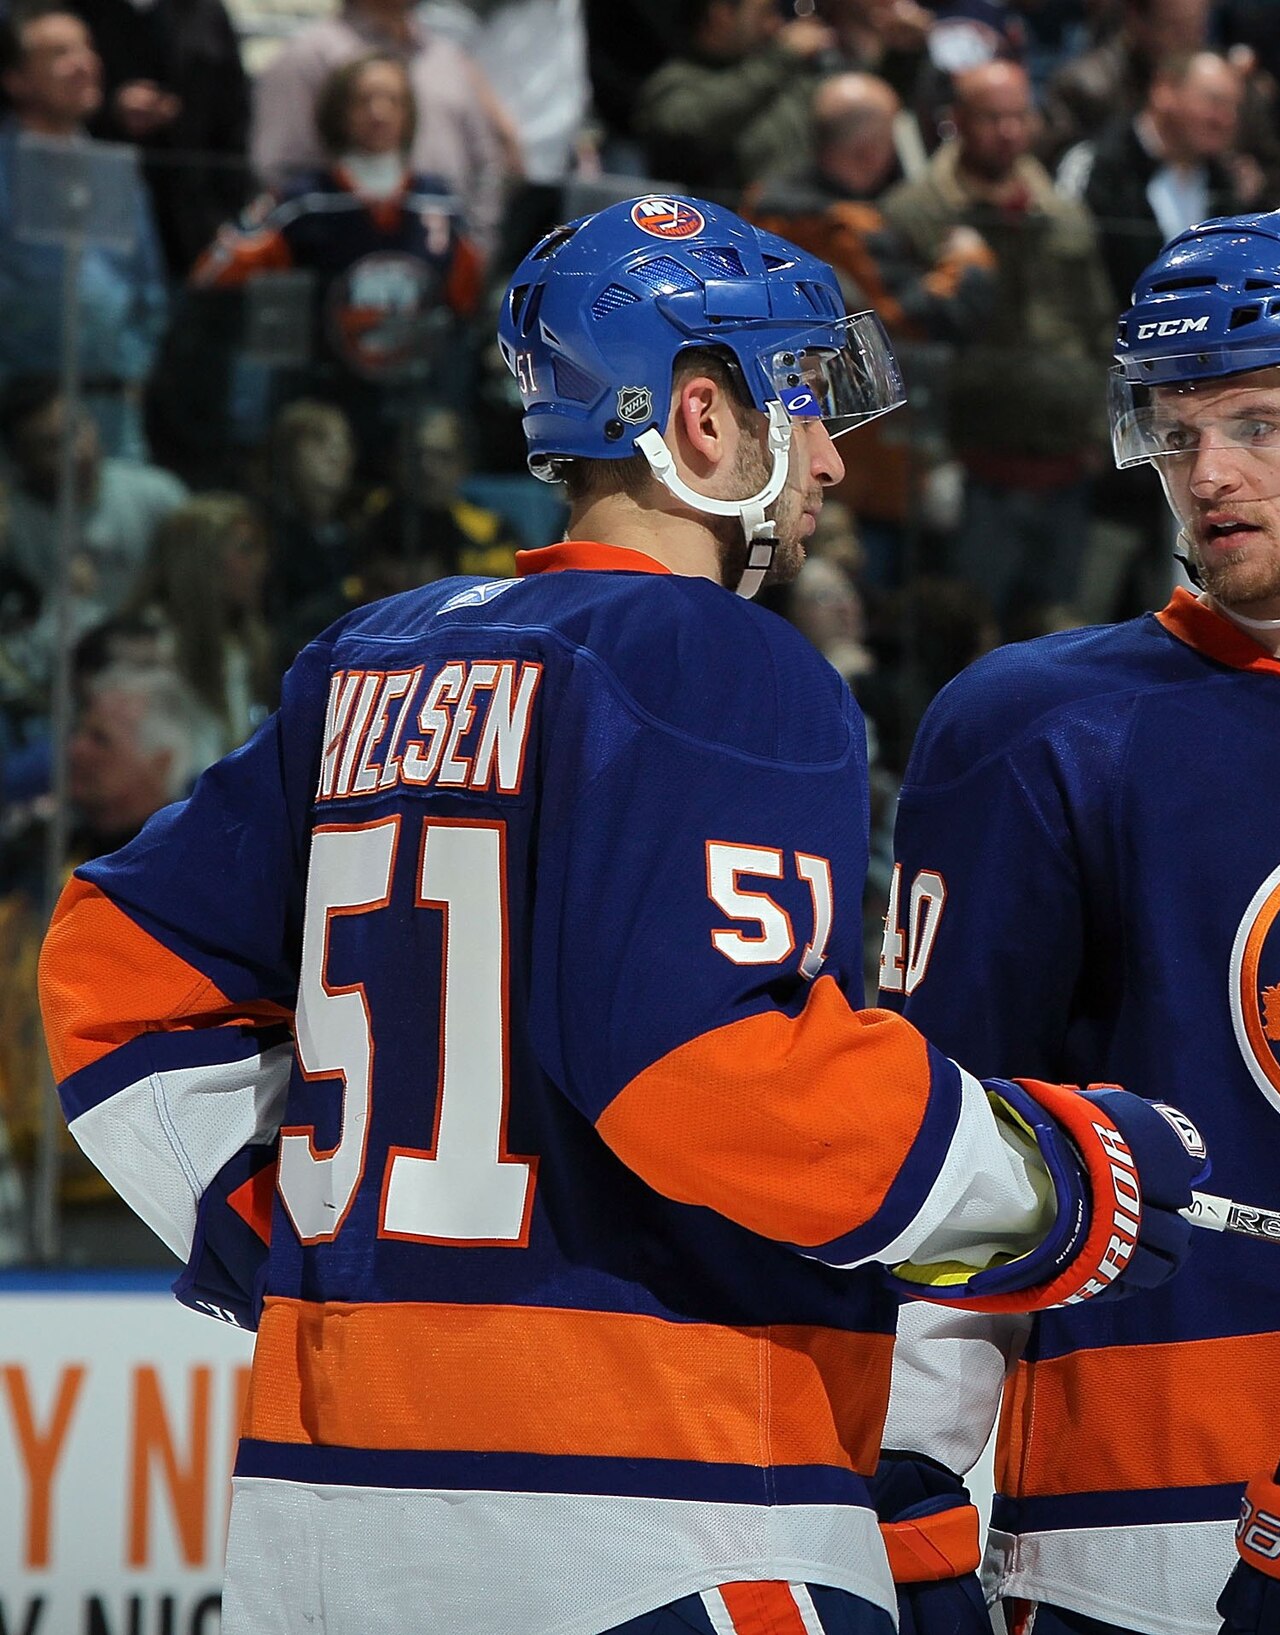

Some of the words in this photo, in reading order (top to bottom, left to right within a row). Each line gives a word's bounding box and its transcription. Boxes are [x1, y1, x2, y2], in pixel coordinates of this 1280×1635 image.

[639, 200, 679, 218] NY
[515, 352, 538, 394] 51
[1137, 316, 1207, 341] CCM
[624, 397, 647, 416] NHL
[315, 660, 544, 803] NIELSEN
[704, 839, 834, 981] 51
[878, 862, 948, 997] 40
[276, 813, 541, 1250] 51
[1047, 1121, 1140, 1308] RRIOR
